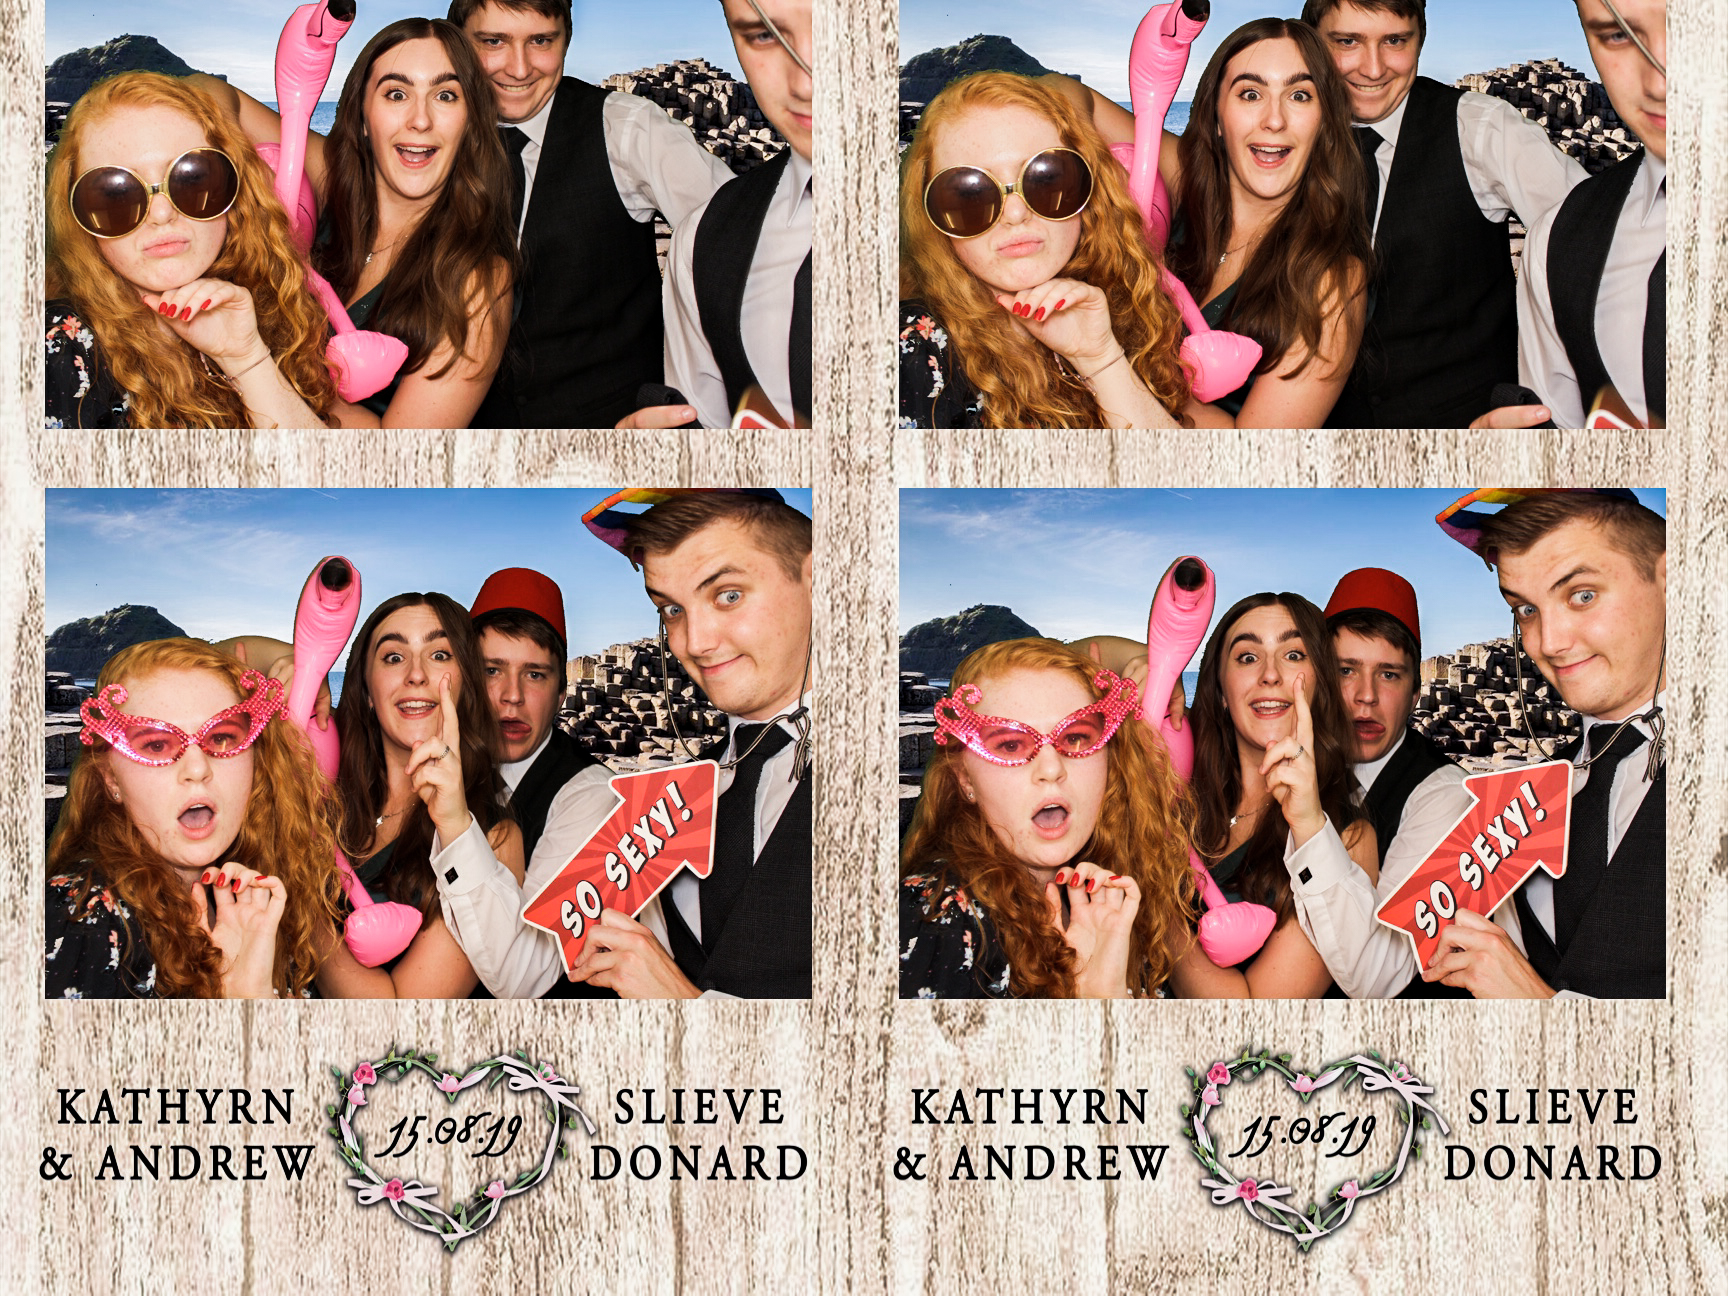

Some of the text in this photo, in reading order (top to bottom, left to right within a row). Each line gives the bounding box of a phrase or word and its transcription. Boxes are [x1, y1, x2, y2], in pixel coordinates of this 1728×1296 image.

[561, 780, 693, 939] SO SEXY!
[1415, 780, 1547, 939] SO SEXY!
